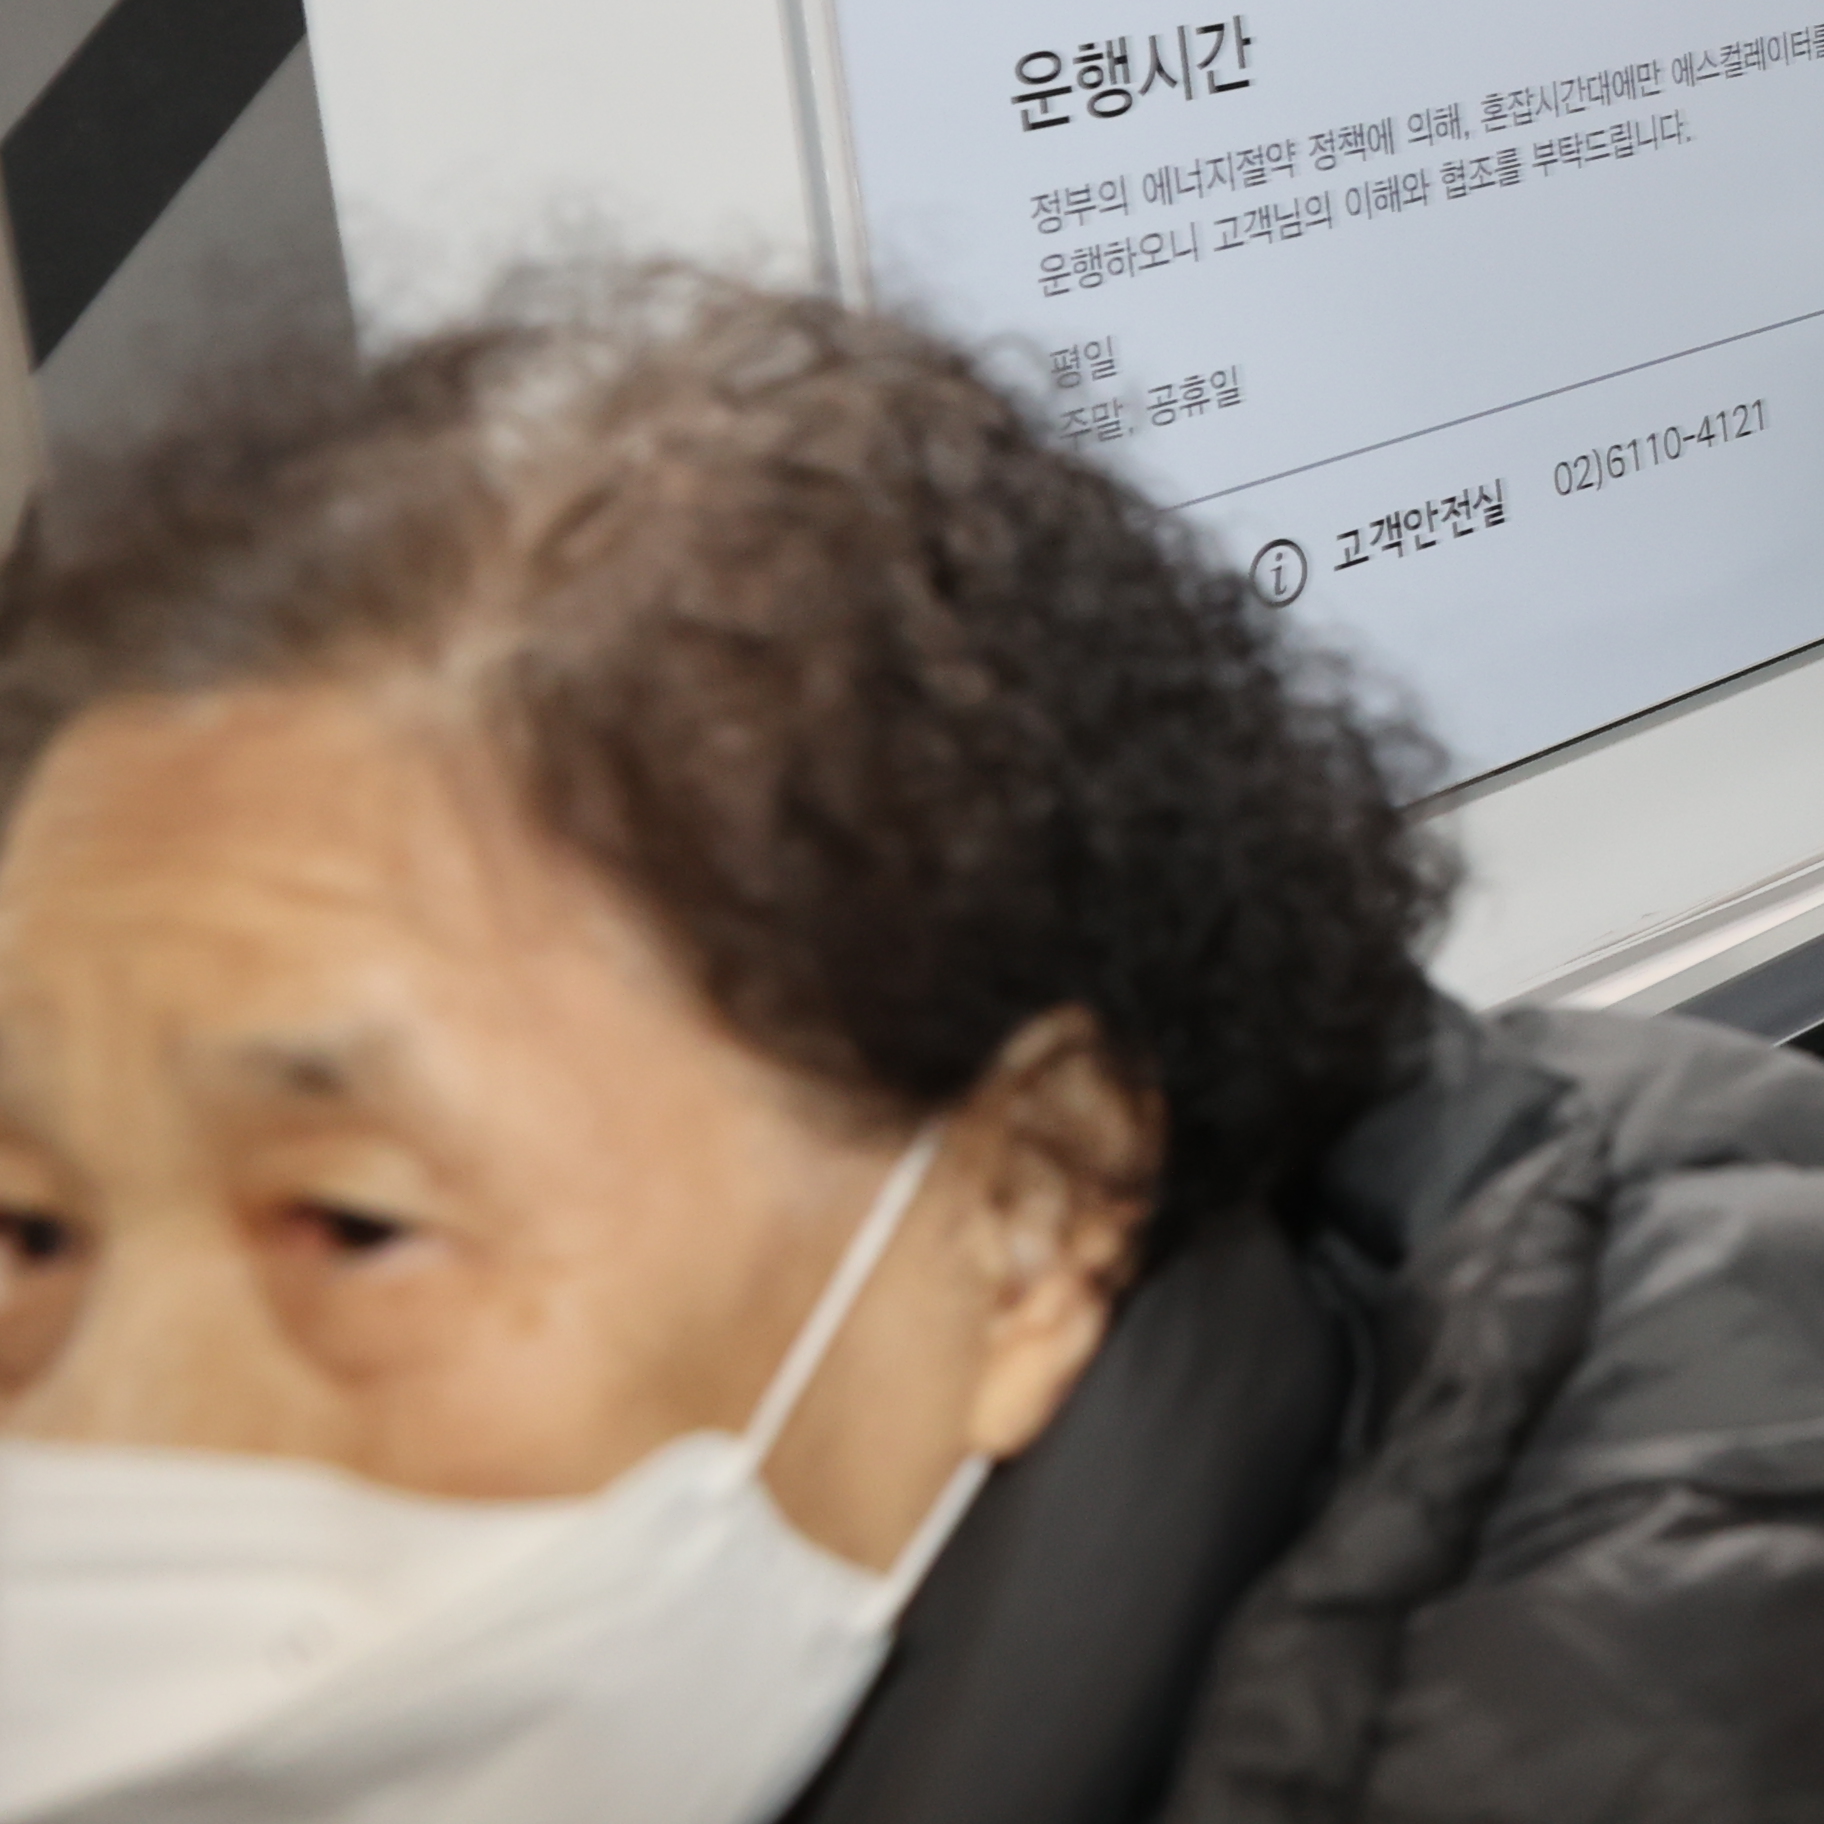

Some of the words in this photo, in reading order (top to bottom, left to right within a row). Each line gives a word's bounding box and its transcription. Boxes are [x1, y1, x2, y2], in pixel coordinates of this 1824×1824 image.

[1010, 14, 1253, 133] 운행시간
[1030, 174, 1130, 235] 정부의
[1142, 138, 1297, 207] 에너지절약
[1307, 116, 1396, 172] 정책에
[1406, 102, 1471, 147] 의해,
[1480, 61, 1662, 133] 혼잡시간대에만
[1037, 221, 1201, 298] 운행하오니
[1213, 190, 1333, 253] 고객님의
[1345, 166, 1431, 221] 이해와
[1440, 146, 1524, 201] 협조를
[1531, 108, 1693, 177] 부탁드립니다.
[1050, 334, 1118, 390] 평일
[1146, 364, 1242, 428] 공휴일
[1332, 477, 1509, 572] 고객안전실
[1553, 398, 1768, 497] 02)6110-4121
